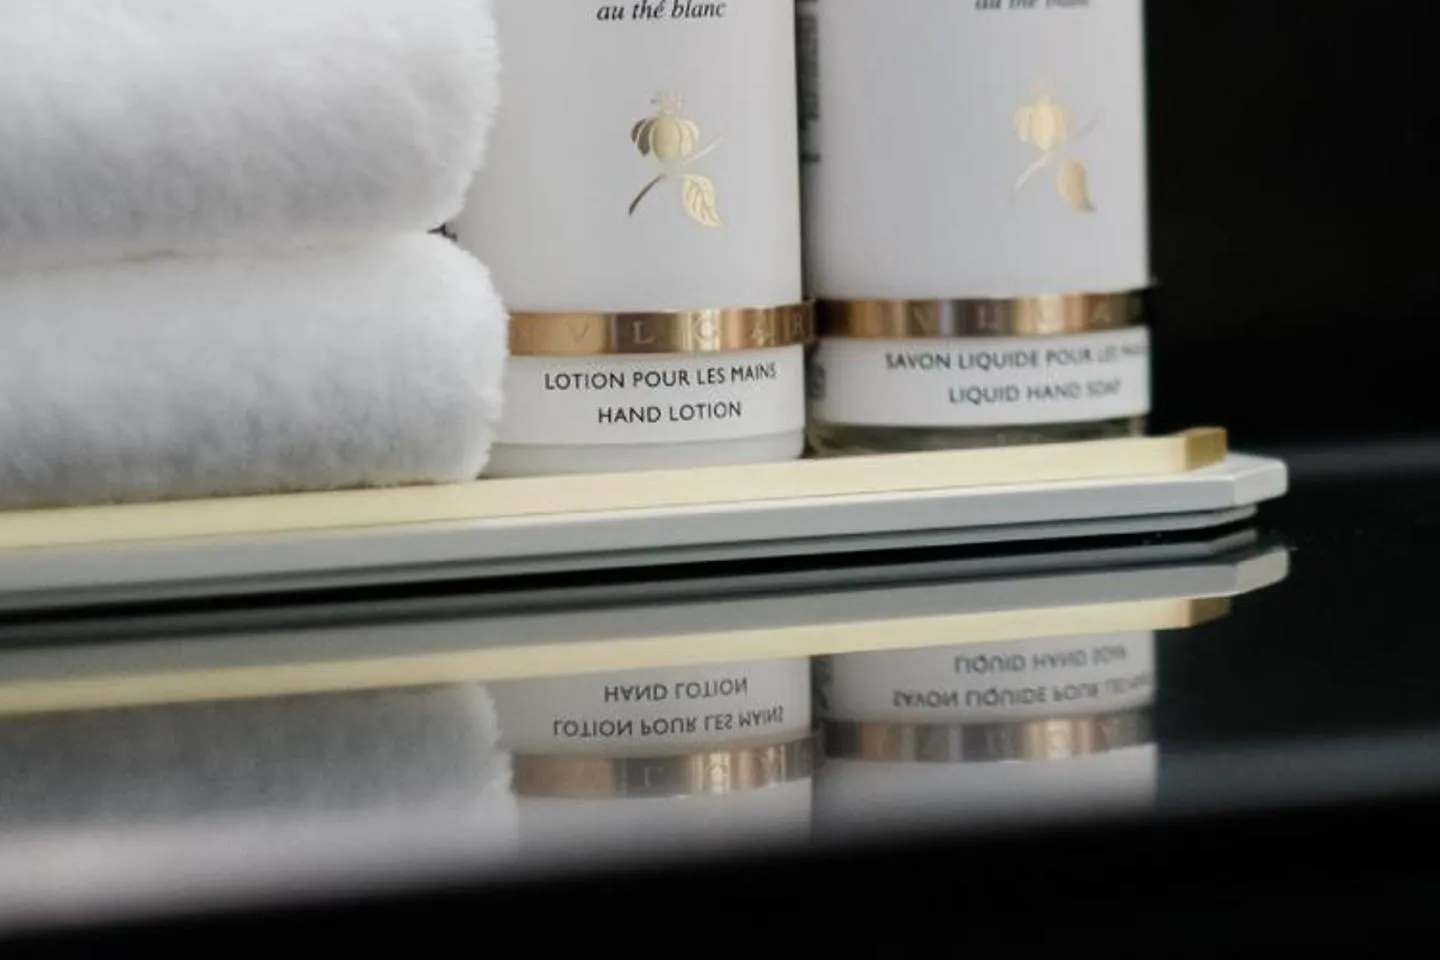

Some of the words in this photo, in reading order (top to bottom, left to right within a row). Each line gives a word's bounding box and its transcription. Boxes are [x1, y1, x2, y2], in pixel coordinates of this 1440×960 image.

[596, 3, 624, 21] au
[885, 351, 951, 370] SAVON
[957, 350, 1039, 371] LIQUIDE
[543, 372, 625, 391] LOTION
[632, 369, 691, 389] POUR
[696, 367, 726, 385] LES
[730, 361, 778, 383] MAINS
[947, 385, 1021, 406] LIQUID
[1026, 382, 1082, 402] HAND
[597, 406, 662, 424] HAND
[668, 401, 743, 422] LOTION
